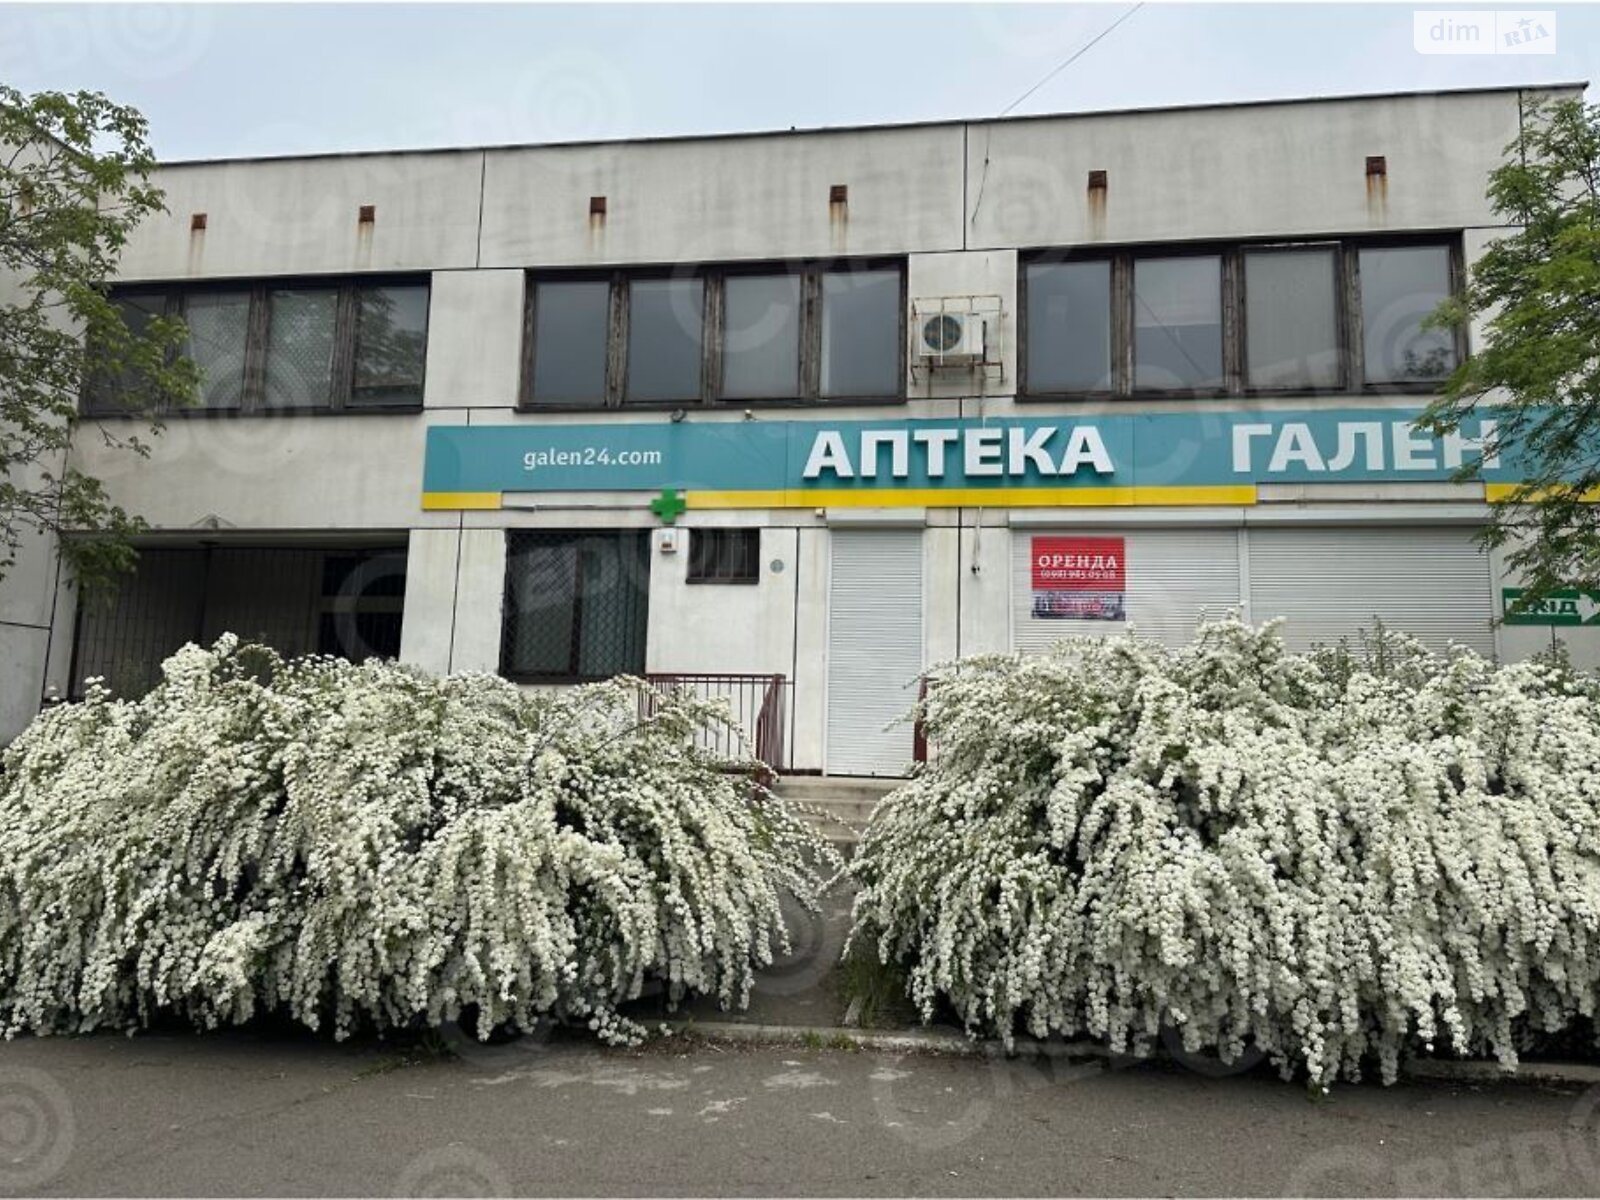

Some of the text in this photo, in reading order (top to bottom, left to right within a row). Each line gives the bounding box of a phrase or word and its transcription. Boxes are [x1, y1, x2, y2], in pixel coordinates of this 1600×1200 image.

[803, 421, 1501, 478] АПТЕКА ГАЛЕН
[523, 448, 662, 470] galen24.com
[1038, 555, 1118, 569] ОРЕНДА
[1513, 600, 1578, 614] ХІД
